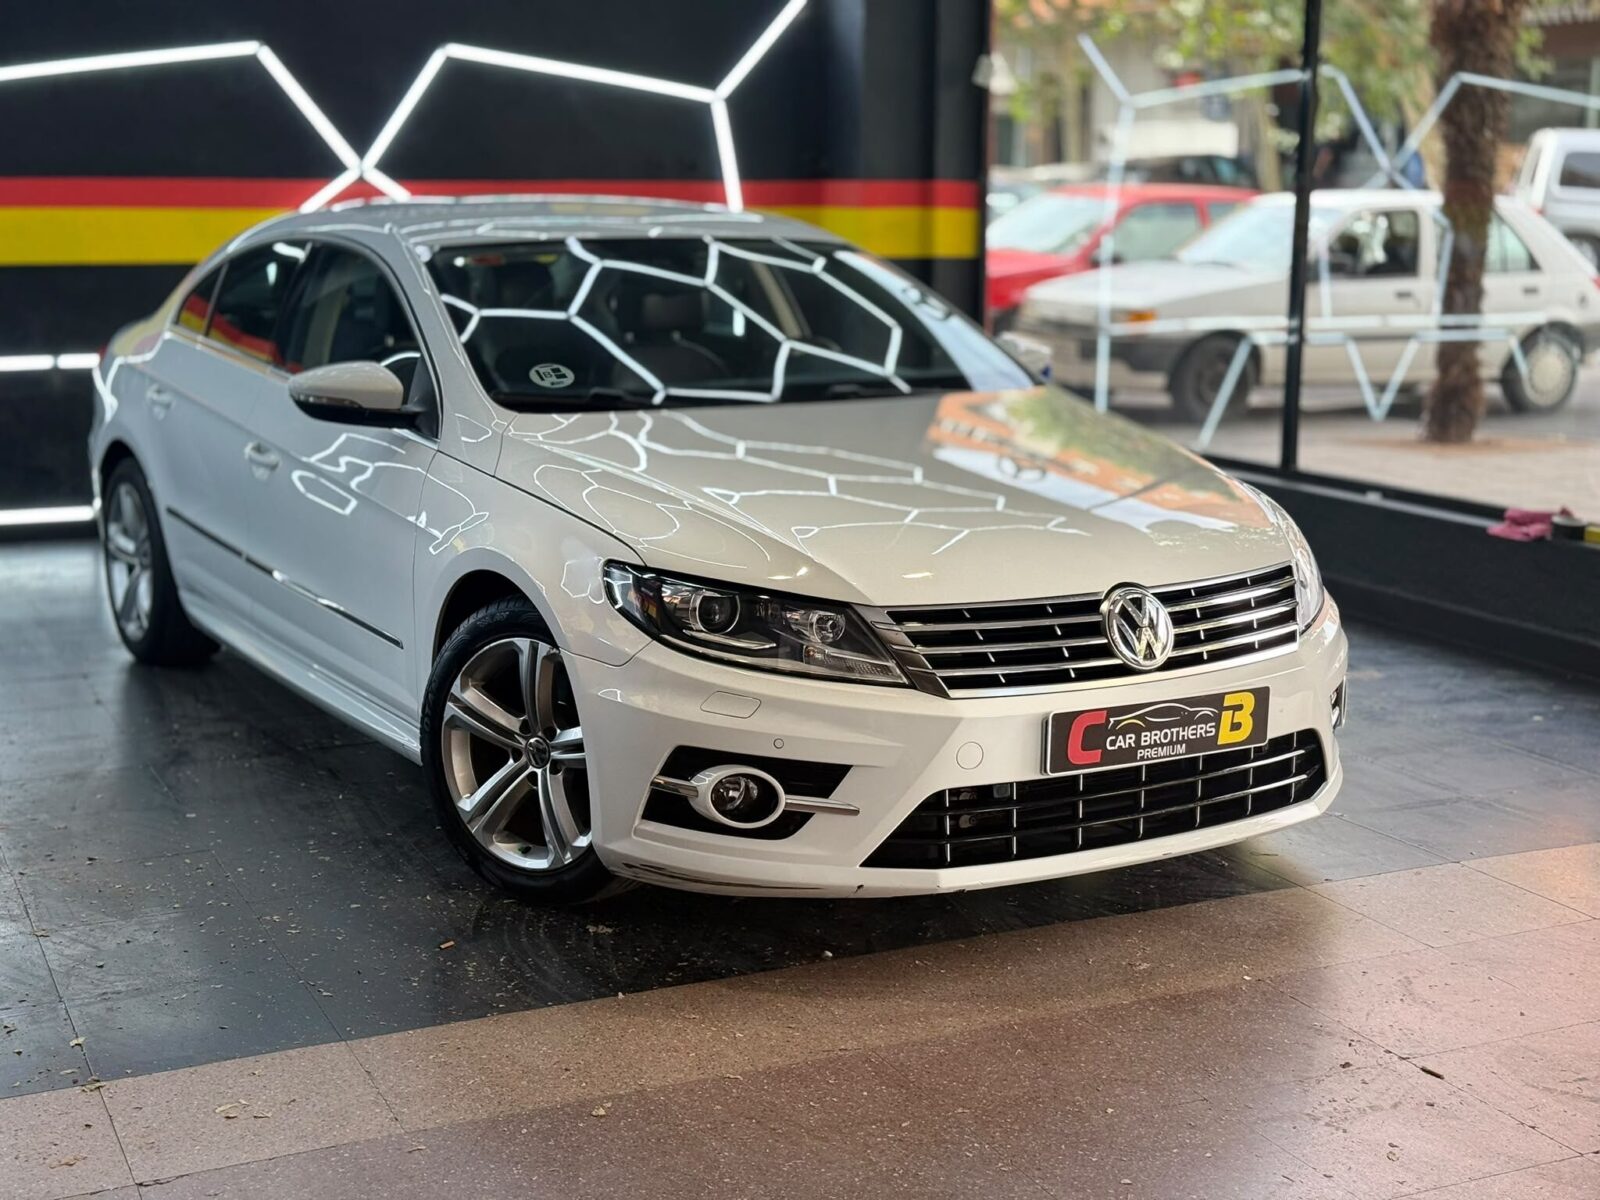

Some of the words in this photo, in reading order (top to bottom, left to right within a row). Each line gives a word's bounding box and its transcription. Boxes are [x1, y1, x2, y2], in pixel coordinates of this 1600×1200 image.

[1067, 710, 1107, 765] C
[1105, 733, 1136, 751] CAR
[1140, 722, 1216, 747] BROTHERS
[1216, 691, 1256, 746] B
[1136, 743, 1186, 761] PREMIUM
